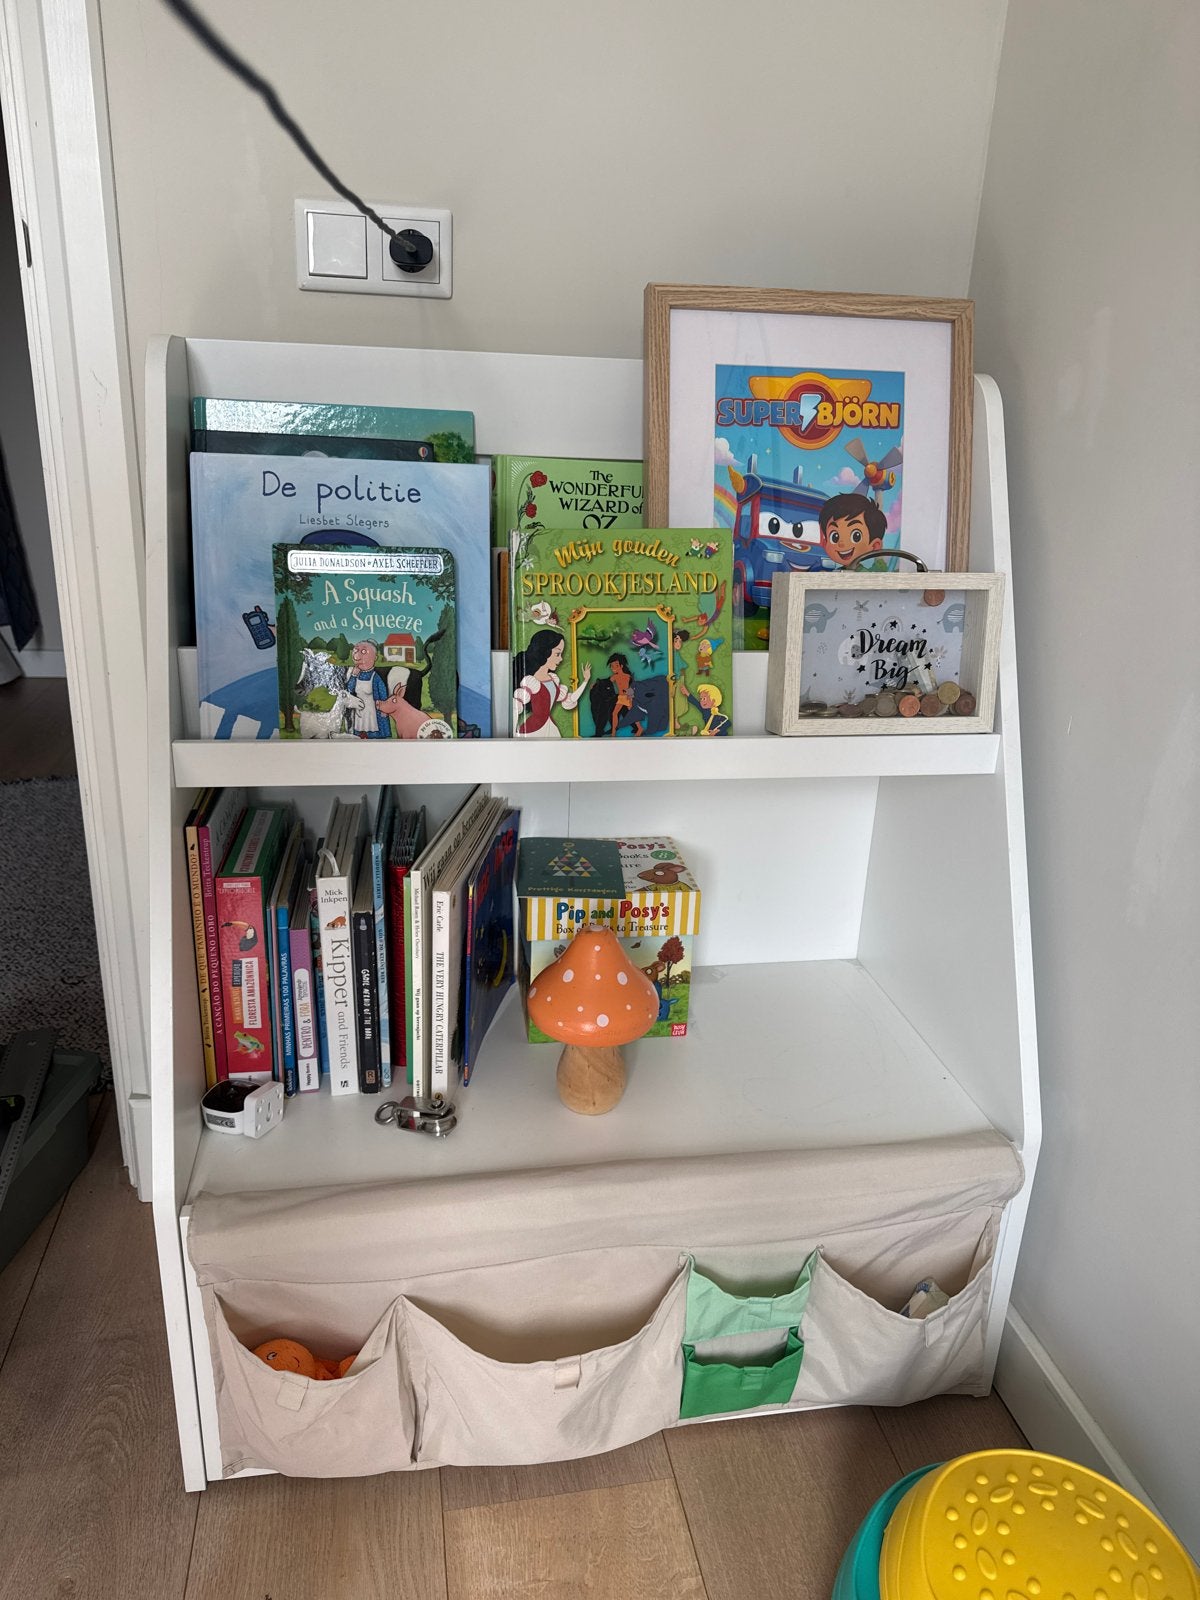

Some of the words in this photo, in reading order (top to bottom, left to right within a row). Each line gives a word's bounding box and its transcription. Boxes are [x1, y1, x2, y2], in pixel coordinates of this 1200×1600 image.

[717, 398, 802, 427] SUPER
[816, 397, 900, 429] BJÖRN
[589, 470, 613, 483] The
[262, 470, 297, 498] De
[317, 474, 422, 514] politie
[558, 497, 629, 514] WIZARD
[299, 514, 340, 526] Liesbet
[346, 514, 390, 530] Slegers
[582, 513, 618, 529] OZ
[293, 556, 318, 568] JULIA
[319, 557, 366, 568] DONALDSON
[372, 558, 394, 568] AXEL
[396, 558, 438, 570] SCHEFFLER
[554, 539, 604, 569] Mijn
[612, 538, 681, 569] gouden
[321, 579, 341, 606] A
[343, 578, 417, 610] Squash
[521, 571, 719, 600] SPROOKJESLAND
[314, 614, 337, 632] and
[341, 618, 348, 628] a
[352, 606, 423, 634] Squeeze
[856, 628, 929, 659] Dream
[871, 659, 920, 690] Big
[201, 838, 212, 876] Teckentrup
[617, 841, 666, 850] Posy's
[190, 854, 200, 891] MUNDO?
[422, 862, 436, 890] Wij
[204, 878, 213, 898] Britta
[207, 914, 216, 938] LOBO
[556, 901, 586, 924] Pip
[590, 905, 615, 920] and
[620, 900, 670, 922] Posy's
[193, 910, 204, 952] TAMANHO
[556, 924, 574, 934] Box
[616, 924, 626, 933] to
[628, 921, 669, 933] Treasure
[198, 953, 206, 974] QUE
[208, 938, 220, 978] PEQUENO
[436, 952, 444, 968] THE
[199, 974, 206, 984] DE
[211, 980, 220, 993] DO
[327, 938, 350, 1008] Kipper
[436, 969, 444, 990] VERY
[212, 996, 223, 1028] CANÇÃO
[247, 998, 257, 1026] FLORESTA
[283, 998, 291, 1030] PRIMEIRAS
[300, 1002, 310, 1018] FORA
[338, 1011, 348, 1031] and
[435, 991, 444, 1023] HUNGRY
[300, 1026, 312, 1049] DENTRO
[339, 1032, 350, 1070] Friends
[435, 1025, 444, 1074] CATERPILLAR
